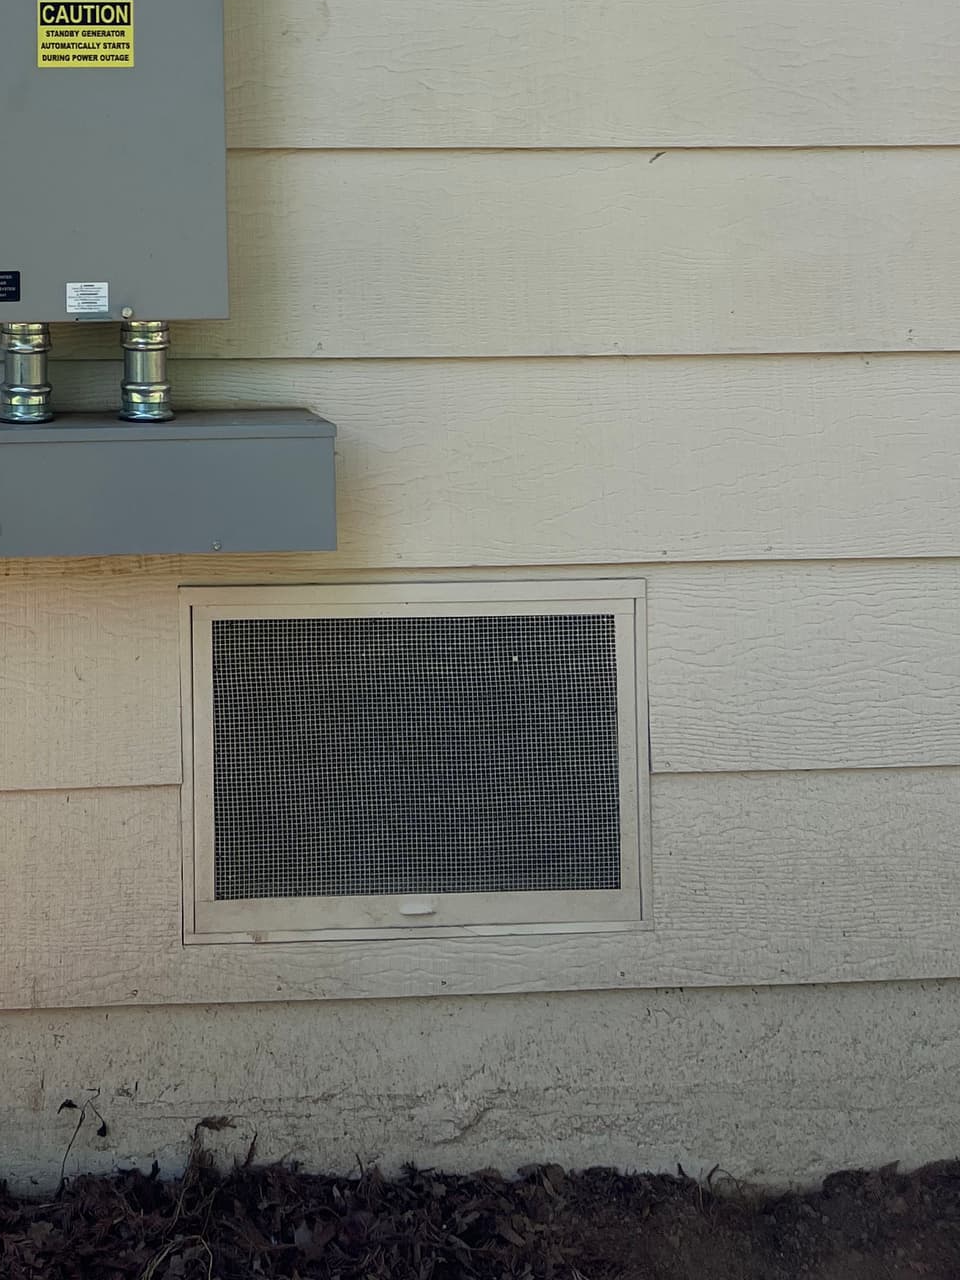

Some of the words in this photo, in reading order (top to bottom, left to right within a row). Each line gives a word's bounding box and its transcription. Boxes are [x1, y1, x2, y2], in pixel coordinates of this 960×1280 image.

[42, 4, 128, 24] CAUTION
[45, 30, 79, 38] STANDBY
[41, 42, 101, 50] AUTOMATICALLY
[103, 42, 130, 50] STARTS
[72, 54, 98, 62] POWER
[100, 54, 129, 62] OUTAGE
